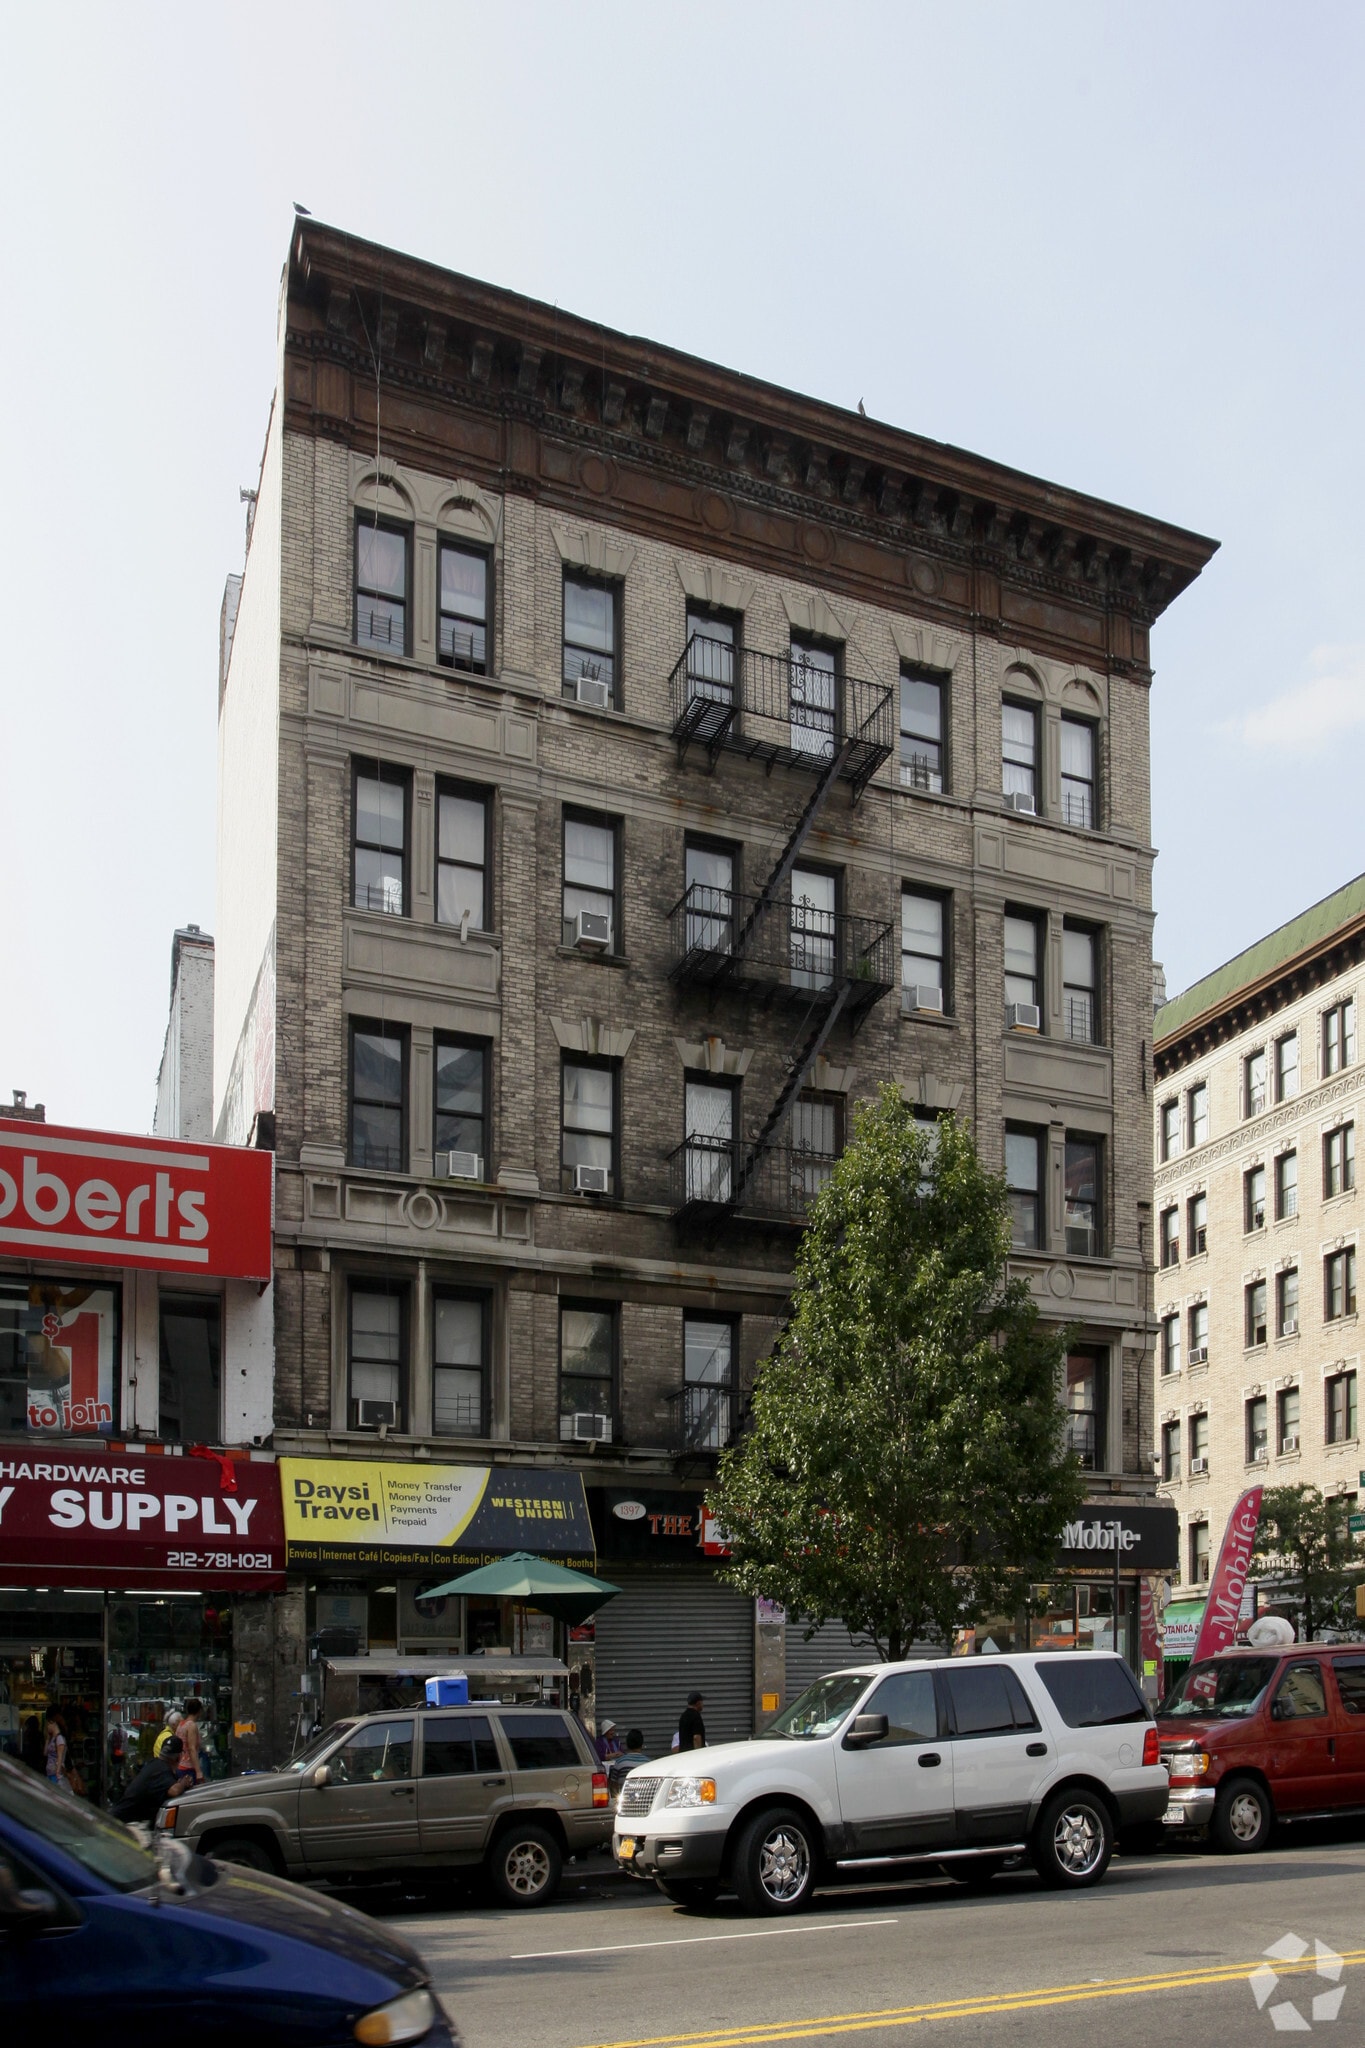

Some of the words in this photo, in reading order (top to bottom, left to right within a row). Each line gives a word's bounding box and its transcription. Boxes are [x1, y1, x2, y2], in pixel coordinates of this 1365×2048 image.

[28, 1403, 58, 1428] to
[62, 1398, 112, 1430] join
[0, 1462, 146, 1485] HARDWARE
[294, 1479, 369, 1504] Daysi
[387, 1481, 420, 1491] Money
[423, 1482, 462, 1491] Transfer
[389, 1493, 421, 1503] Money
[425, 1494, 451, 1503] Order
[491, 1498, 562, 1509] WESTERN
[48, 1489, 258, 1535] SUPPLY
[294, 1500, 379, 1521] Travel
[390, 1505, 438, 1514] Payments
[515, 1508, 564, 1519] UNION
[620, 1505, 640, 1516] 1397
[392, 1517, 427, 1527] Prepaid
[647, 1514, 693, 1536] THE
[167, 1552, 272, 1569] 212-781-1021
[289, 1548, 318, 1559] Envios
[322, 1549, 357, 1561] Internet
[383, 1551, 430, 1564] Copies/Fax
[434, 1554, 450, 1563] Con
[452, 1554, 480, 1565] Edison
[567, 1558, 594, 1568] Booths
